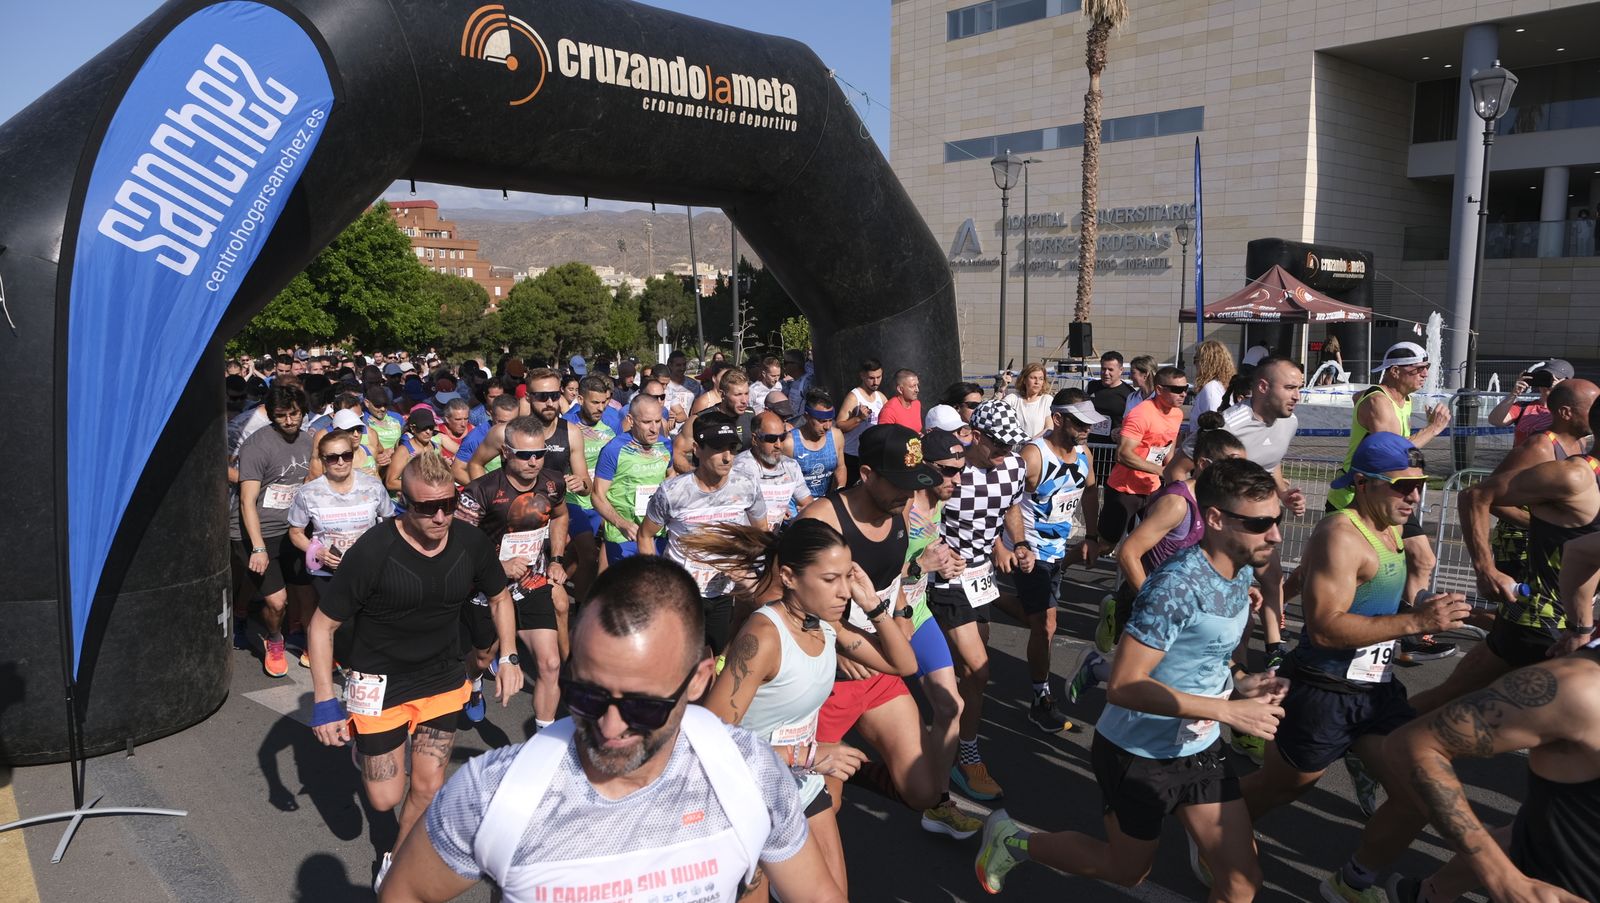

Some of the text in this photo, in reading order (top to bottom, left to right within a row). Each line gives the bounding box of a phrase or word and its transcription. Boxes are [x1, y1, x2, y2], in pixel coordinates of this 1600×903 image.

[642, 96, 797, 132] cronometraje deportivo
[205, 108, 325, 292] centrohogarsanchez.es
[552, 878, 633, 903] CARRERA
[637, 870, 667, 892] SIN
[671, 858, 719, 885] HUMO
